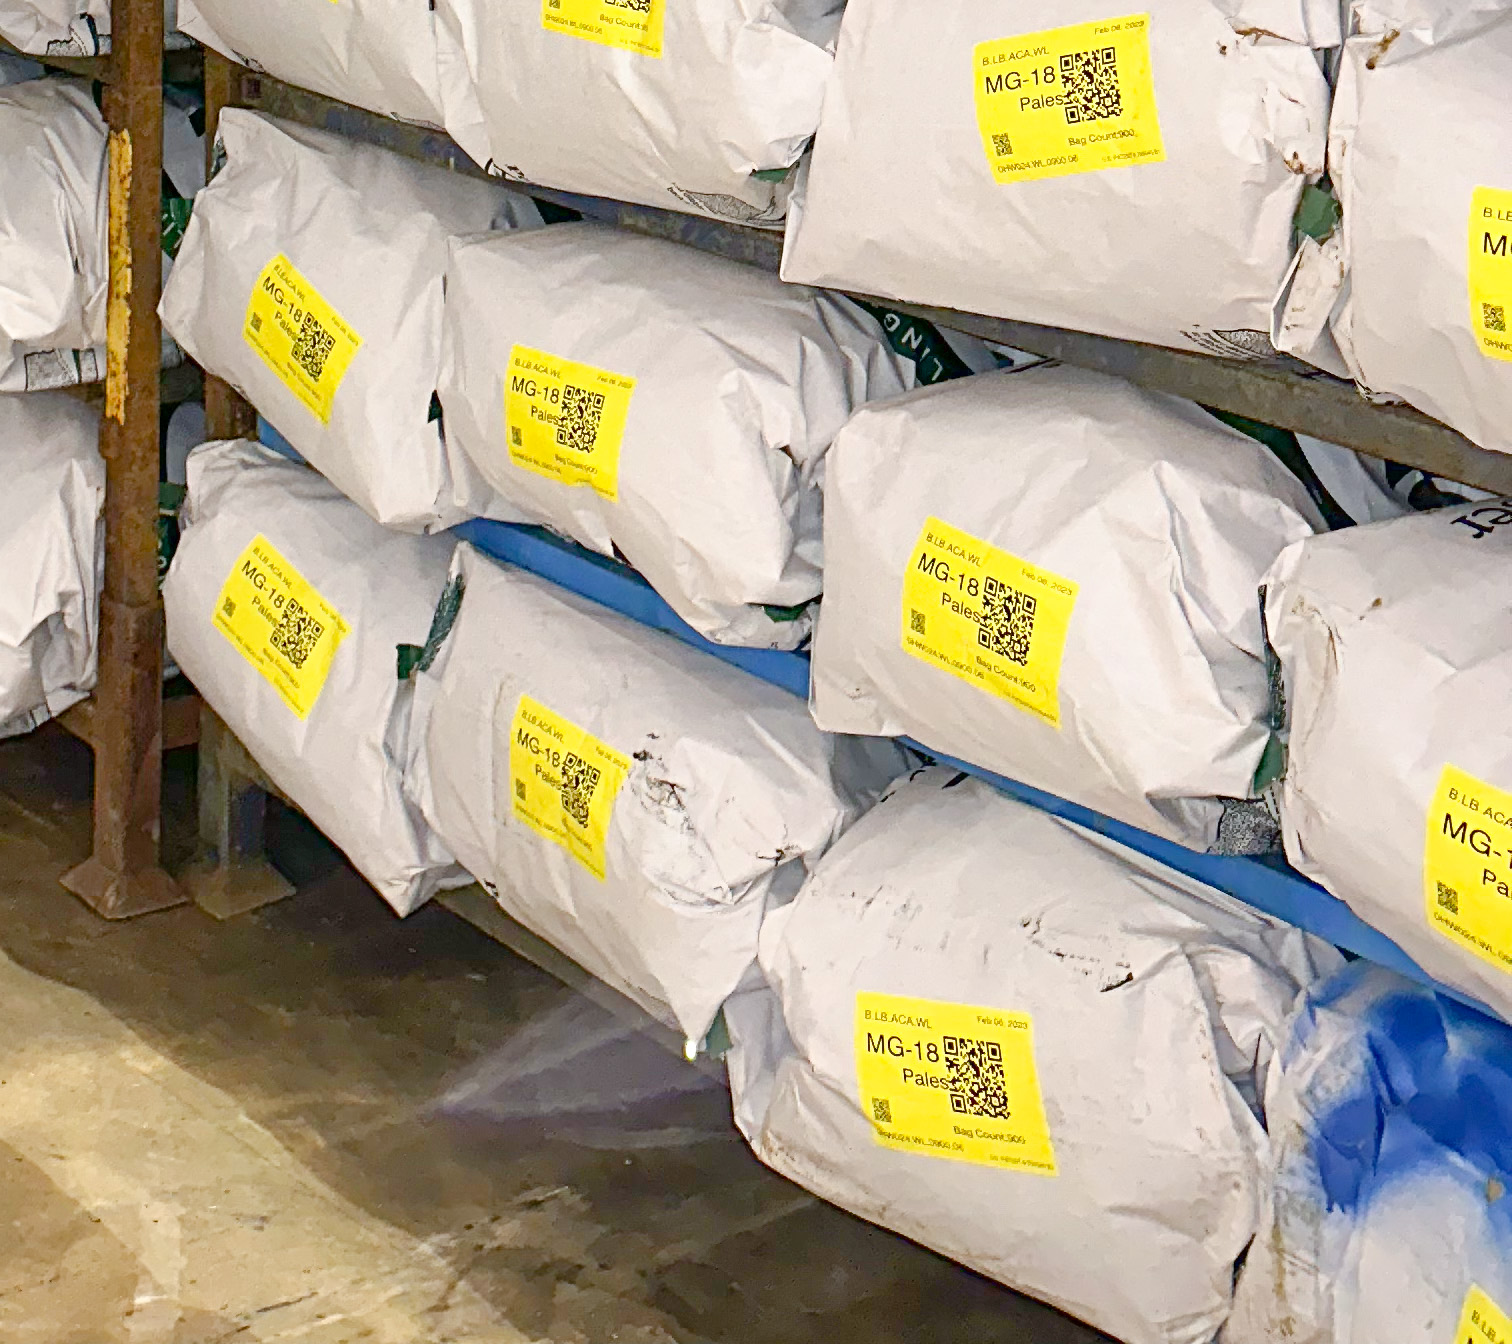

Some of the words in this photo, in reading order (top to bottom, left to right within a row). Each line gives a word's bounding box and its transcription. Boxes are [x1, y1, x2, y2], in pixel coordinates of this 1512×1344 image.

[985, 65, 1056, 95] MG-18
[1068, 136, 1087, 147] Bag
[262, 275, 303, 324] MG-18
[511, 375, 560, 405] MG-18
[241, 559, 285, 609] MG-18
[917, 552, 980, 597] MG-18
[976, 655, 993, 672] Bag
[517, 727, 561, 768] MG-18
[867, 1032, 940, 1063] MG-18
[953, 1125, 974, 1139] Bag
